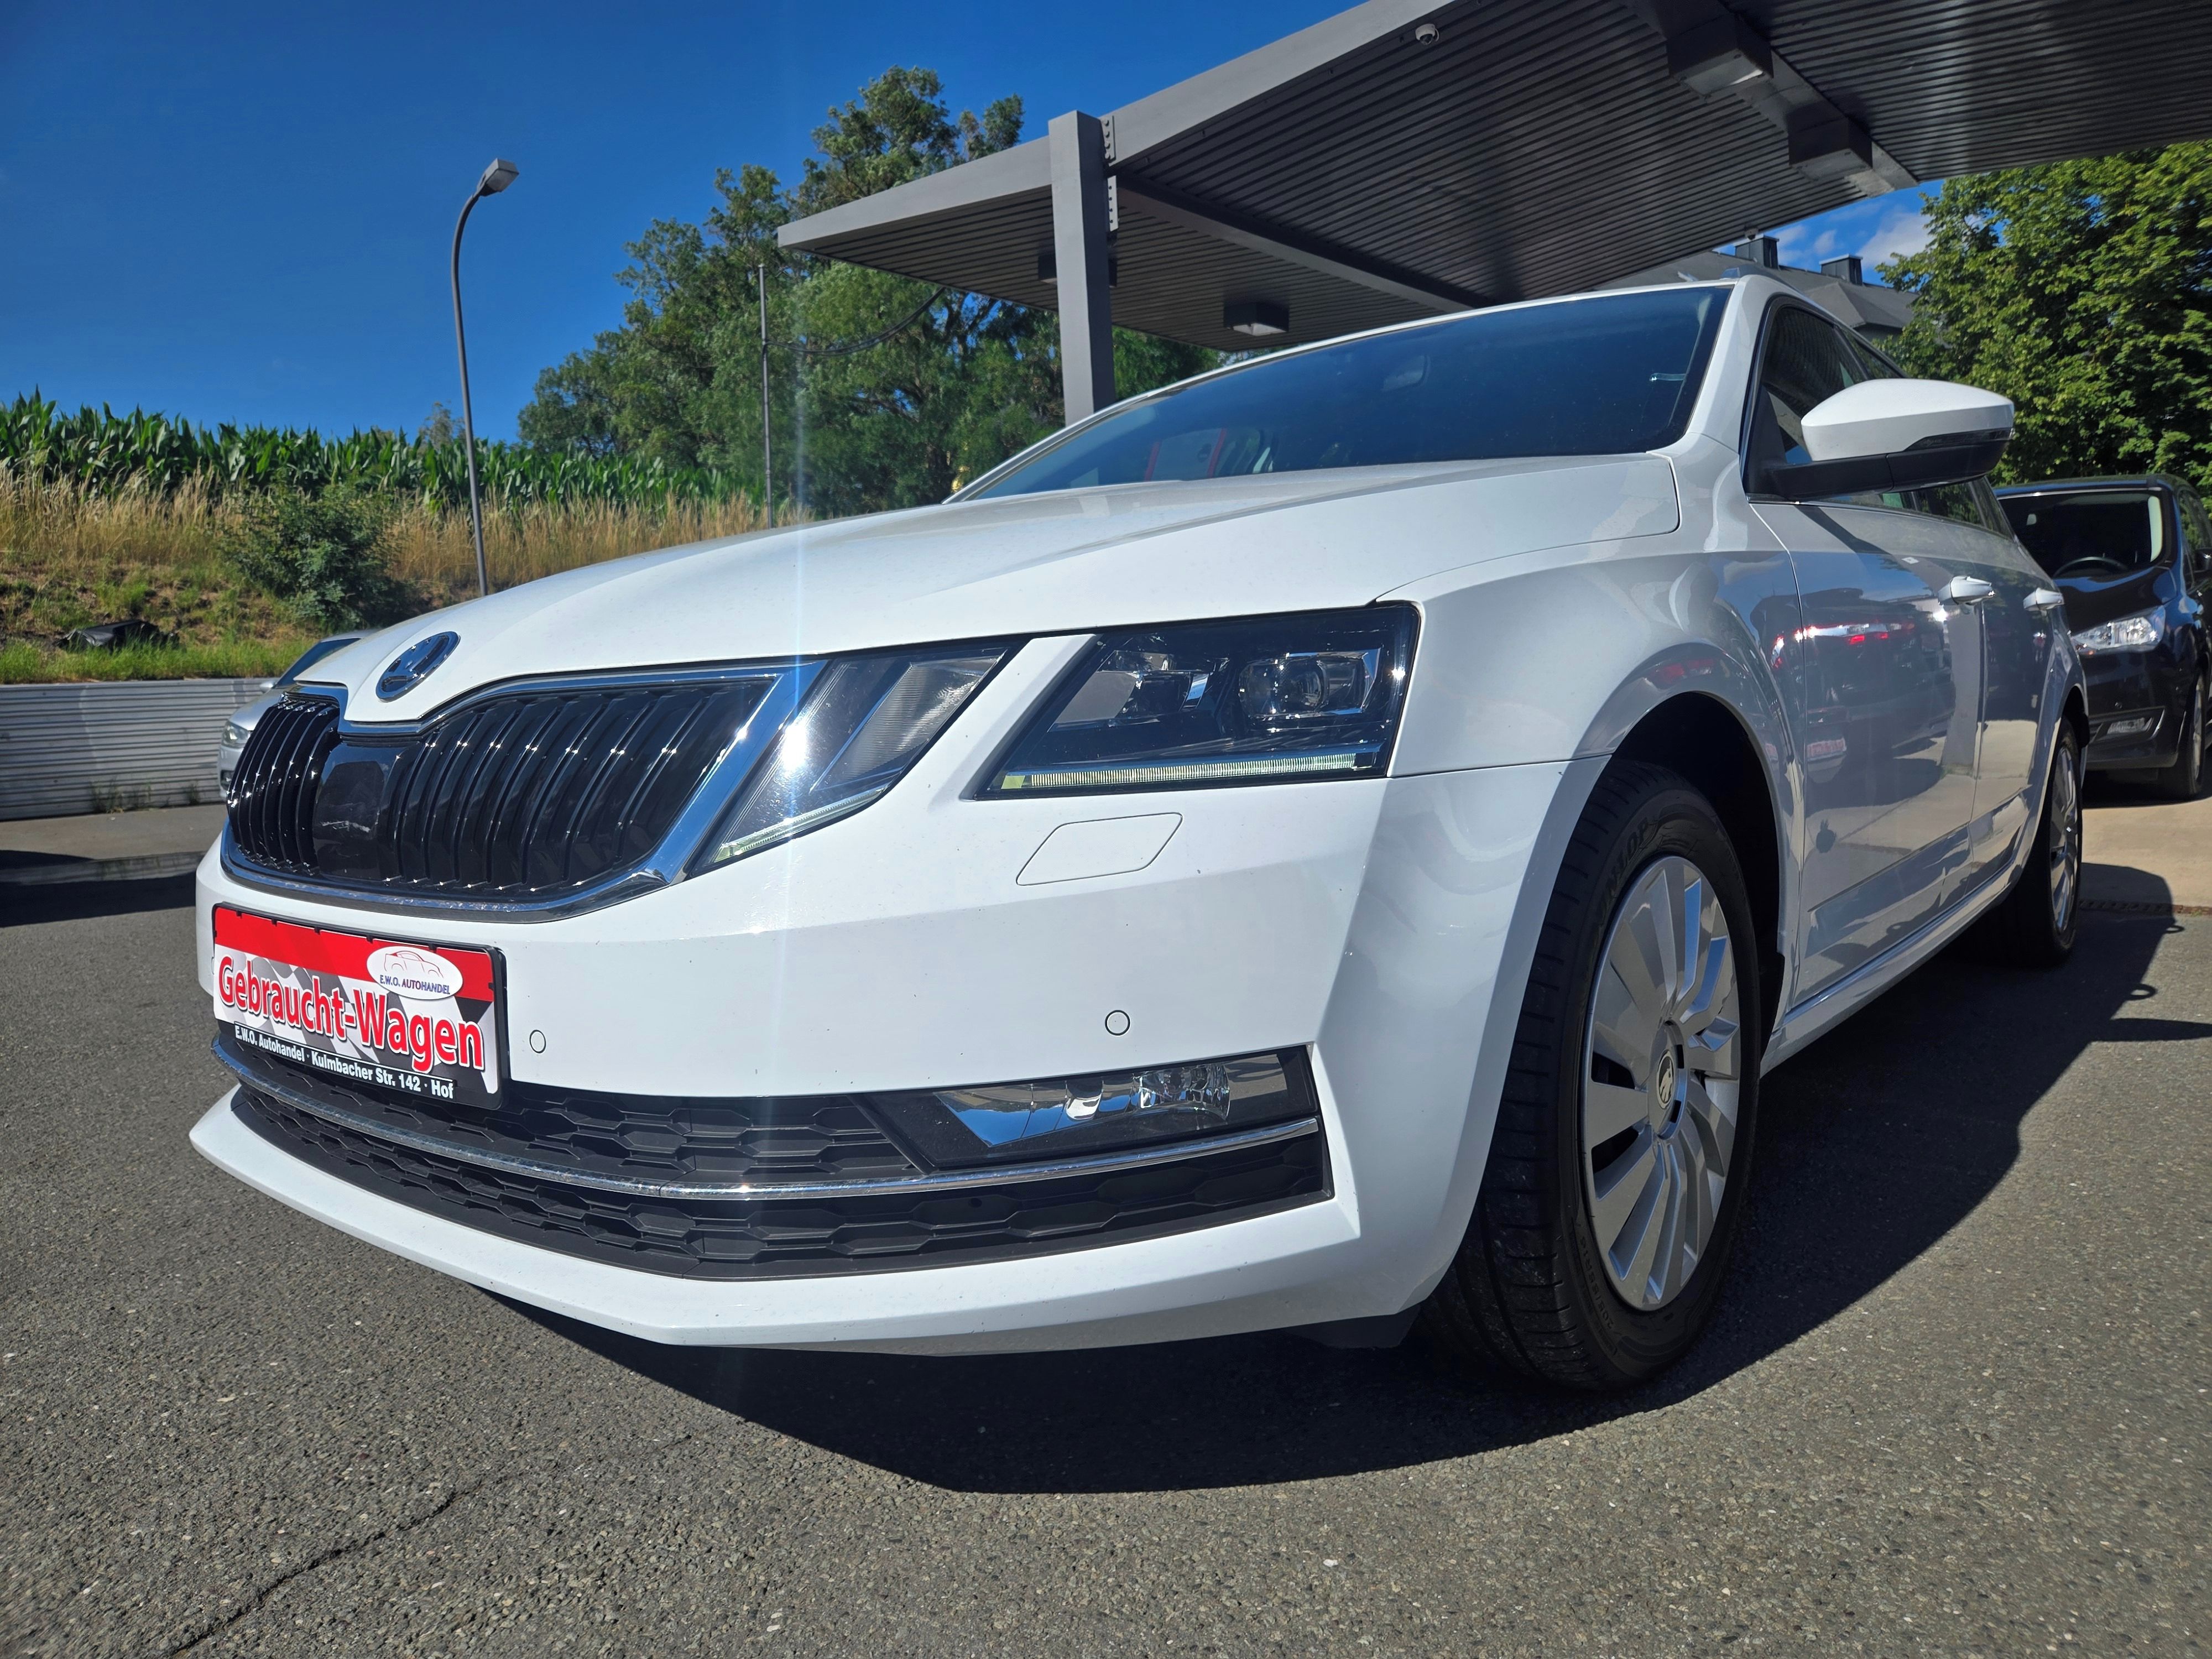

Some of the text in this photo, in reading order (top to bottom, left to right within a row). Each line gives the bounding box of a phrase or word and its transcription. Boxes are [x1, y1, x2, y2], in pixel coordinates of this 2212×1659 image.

[218, 956, 484, 1072] Gebraucht-Wagen
[380, 974, 450, 995] E.W.O. AUTOHANDEL
[234, 1025, 454, 1099] E.W.O. Autohandel Kulmbacher Str. 142 Hof
